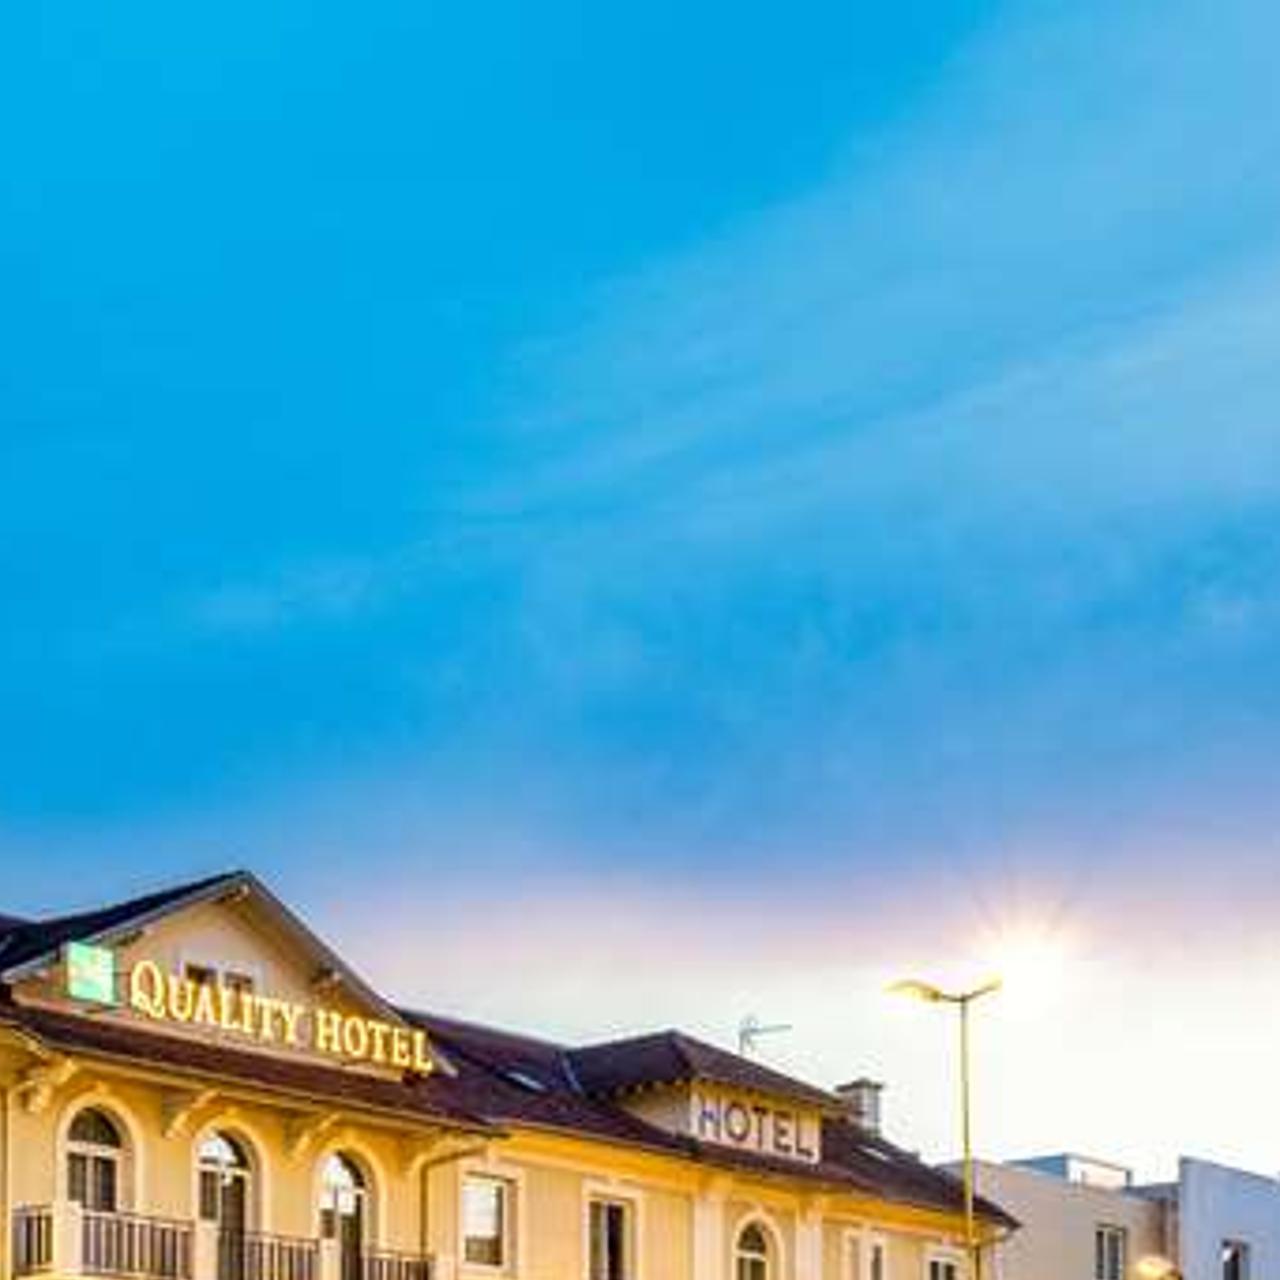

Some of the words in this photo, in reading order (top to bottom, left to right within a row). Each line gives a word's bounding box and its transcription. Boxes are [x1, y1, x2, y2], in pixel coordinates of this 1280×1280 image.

[129, 959, 306, 1044] QUALITY
[316, 1008, 434, 1072] HOTEL
[697, 1101, 815, 1158] HOTEL
